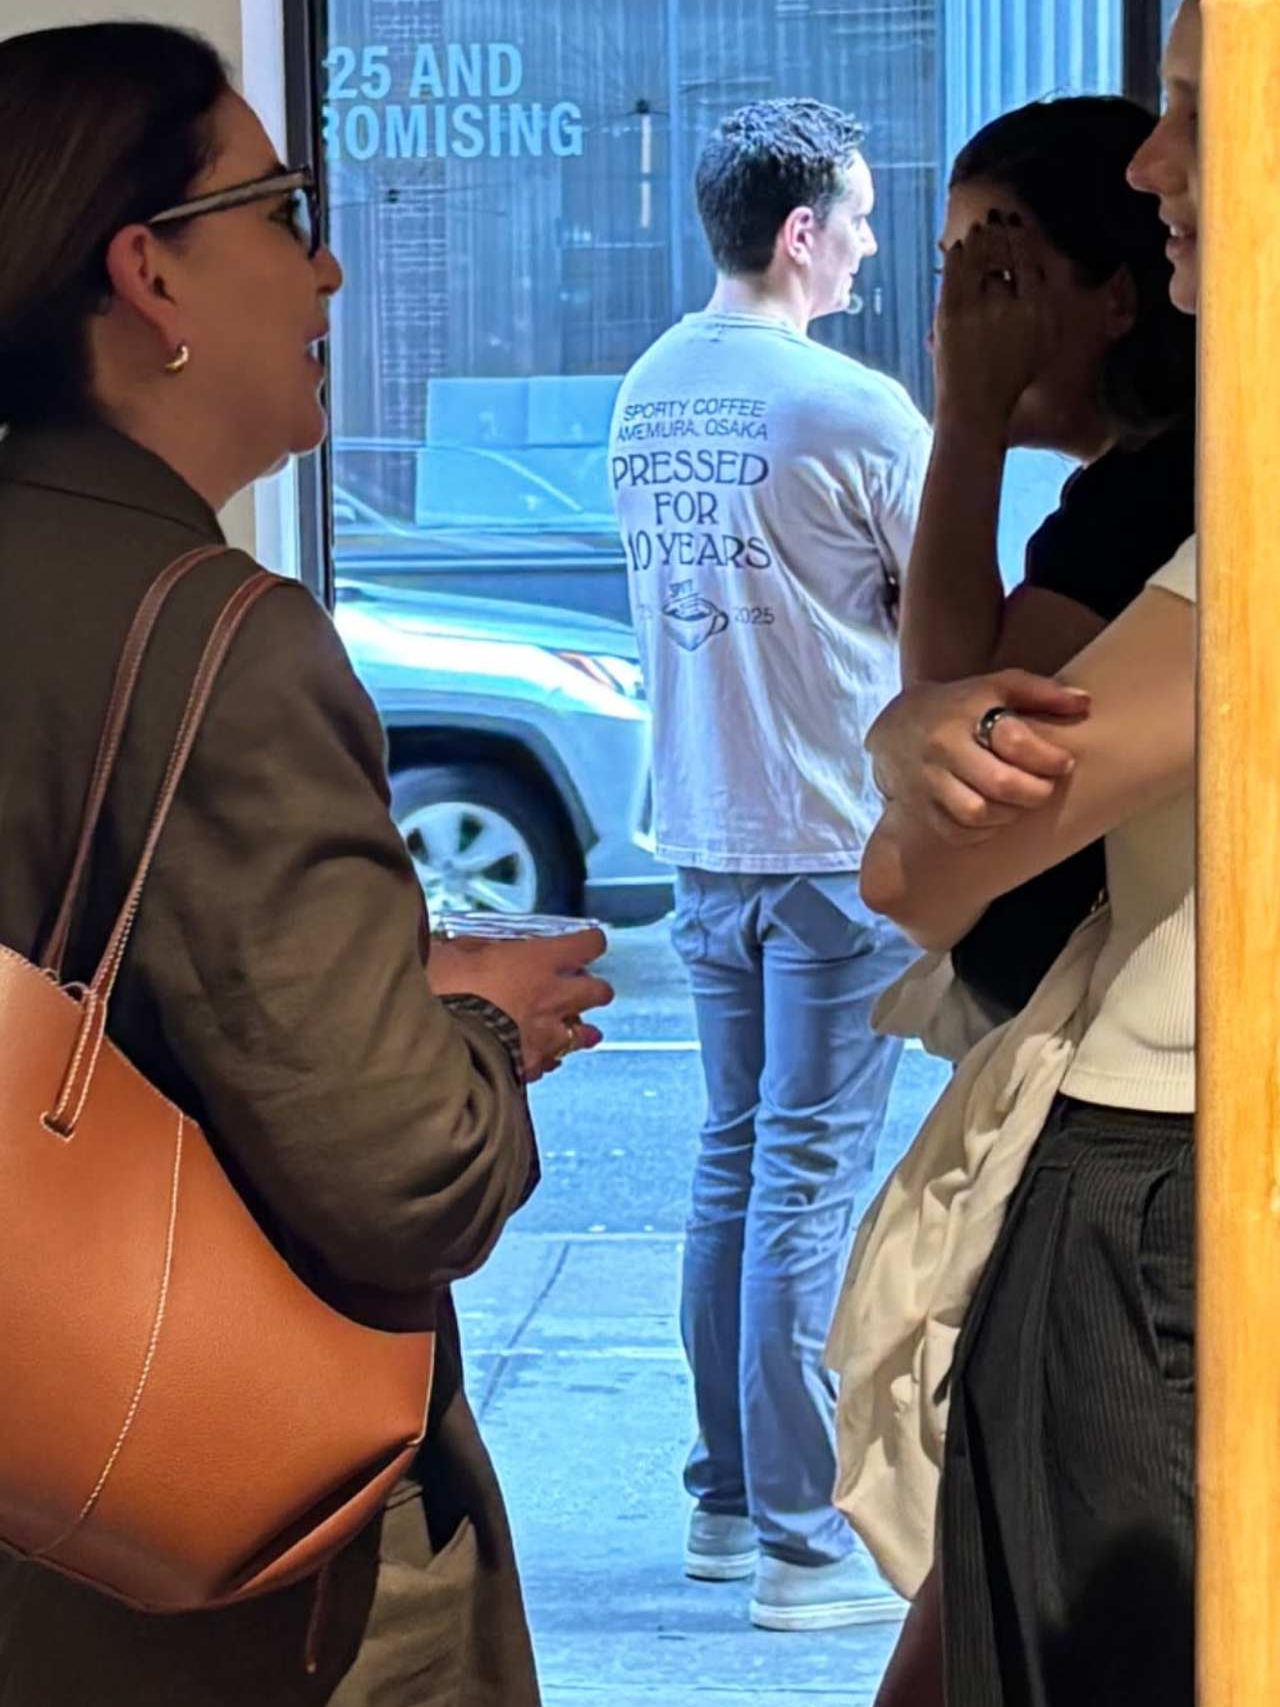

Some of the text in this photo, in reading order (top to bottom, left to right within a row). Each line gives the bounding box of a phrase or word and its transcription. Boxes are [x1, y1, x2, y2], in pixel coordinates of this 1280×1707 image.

[324, 42, 522, 100] 25 AND
[624, 397, 767, 421] SPORTY COFFEE
[705, 418, 768, 440] OSAKA
[612, 449, 769, 491] PRESSED
[654, 490, 718, 525] FOR
[628, 530, 772, 571] 10 YEARS
